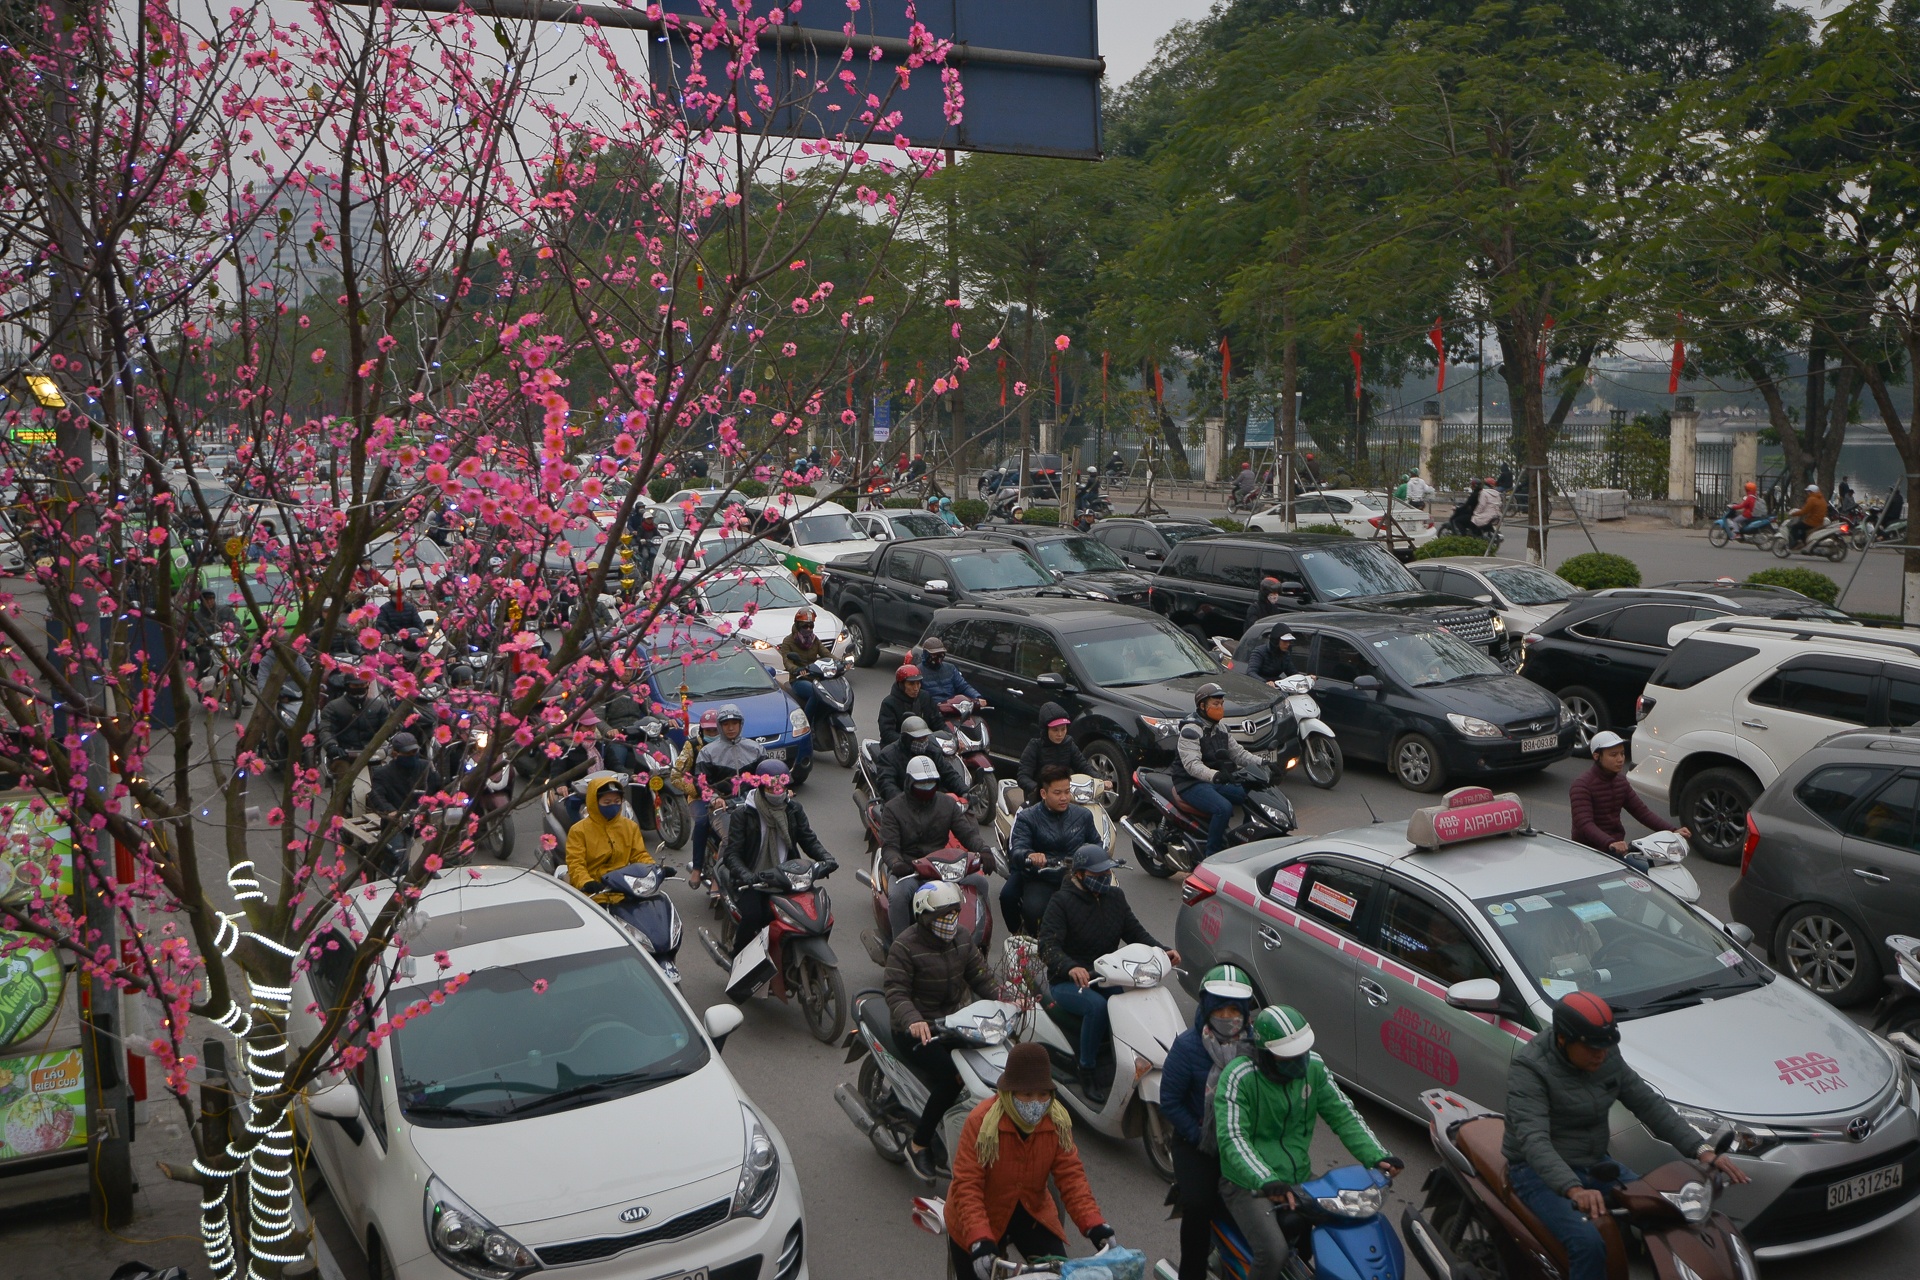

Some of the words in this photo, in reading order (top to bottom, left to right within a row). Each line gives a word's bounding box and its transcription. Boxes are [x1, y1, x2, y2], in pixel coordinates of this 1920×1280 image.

[1438, 815, 1460, 830] ABC
[1464, 808, 1518, 833] AIRPORT
[1393, 1005, 1422, 1030] ABC
[1423, 1018, 1451, 1046] TAXI
[1774, 1051, 1840, 1085] ABC
[58, 1077, 77, 1087] CUA
[1804, 1075, 1849, 1095] TAXI
[623, 1207, 647, 1221] KIA
